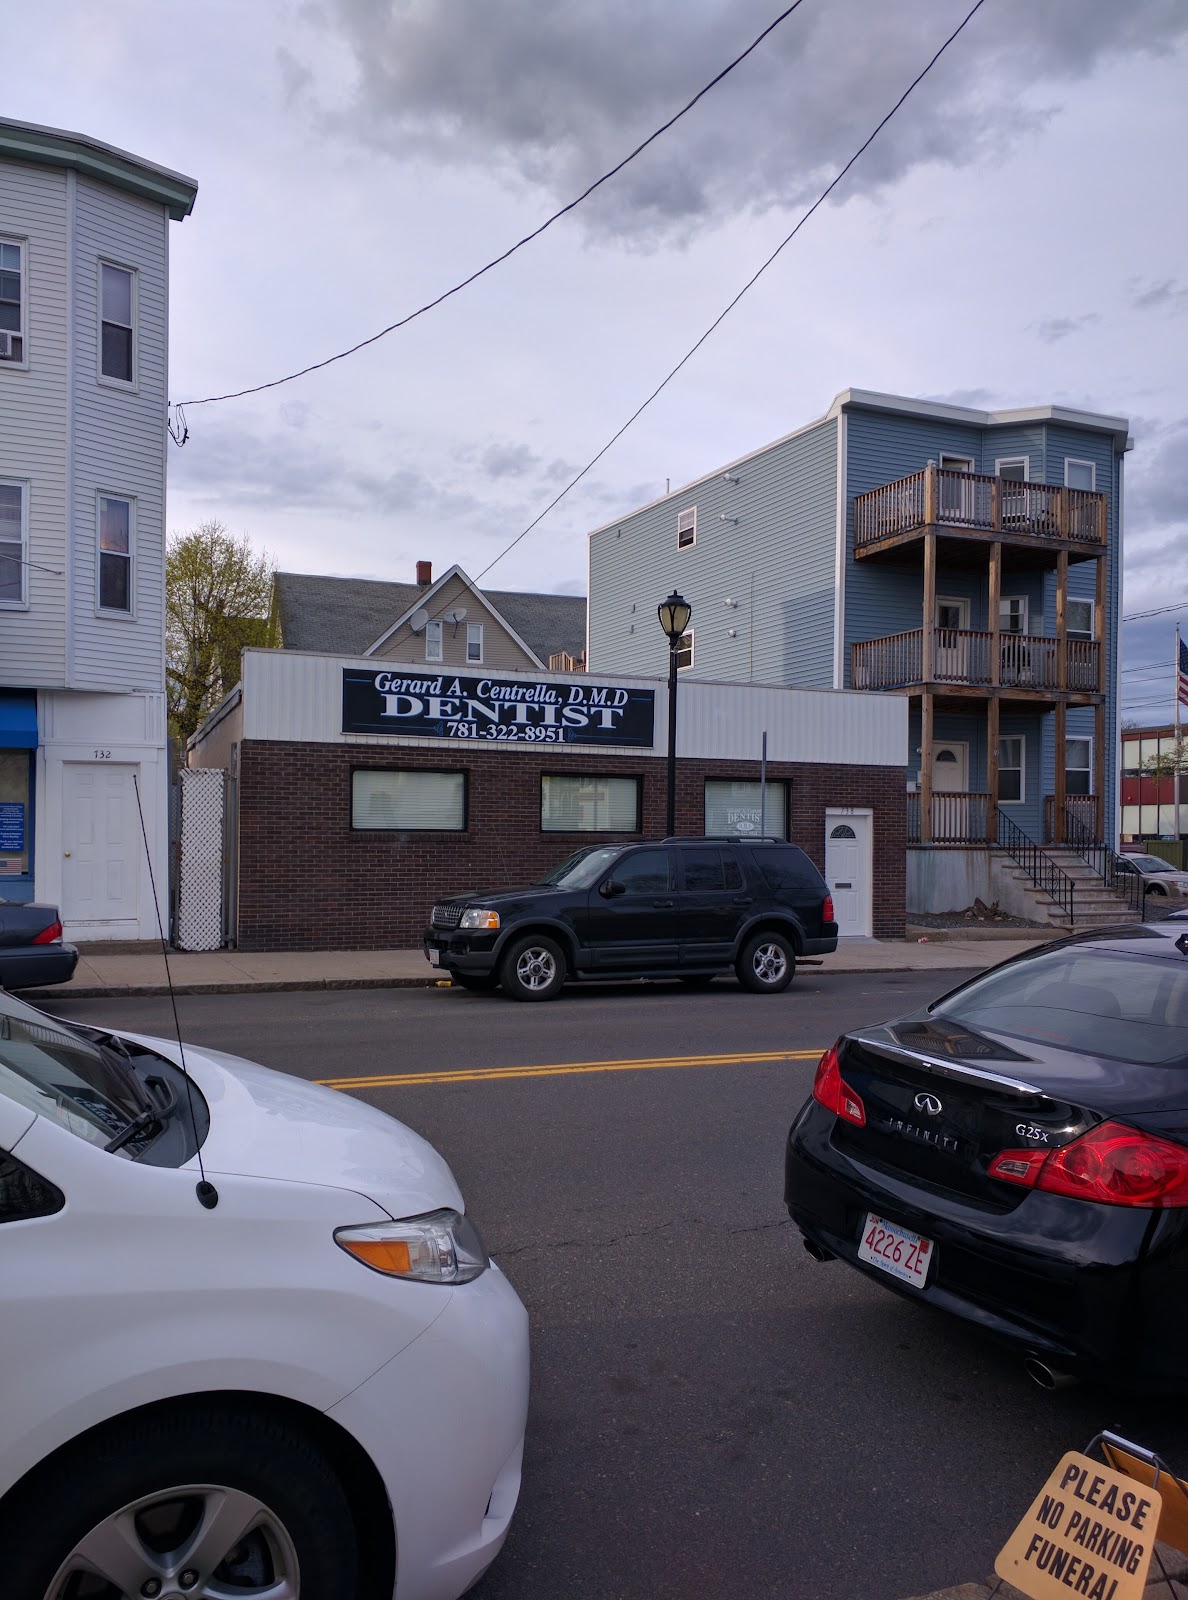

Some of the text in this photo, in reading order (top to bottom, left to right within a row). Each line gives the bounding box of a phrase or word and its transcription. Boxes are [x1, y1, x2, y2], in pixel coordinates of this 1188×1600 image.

[374, 672, 629, 706] Gerard A. Centrella, D.M.D
[380, 693, 624, 729] DENTIST
[446, 721, 566, 742] 781-322-8951
[94, 750, 111, 759] 732
[727, 812, 762, 824] DENTIS
[889, 1117, 958, 1151] INFINITI
[882, 1219, 919, 1244] Massachusetts
[865, 1225, 905, 1263] 4226
[904, 1243, 923, 1276] ZE
[1059, 1463, 1152, 1531] PLEASE
[1035, 1494, 1145, 1576] NO PARKING
